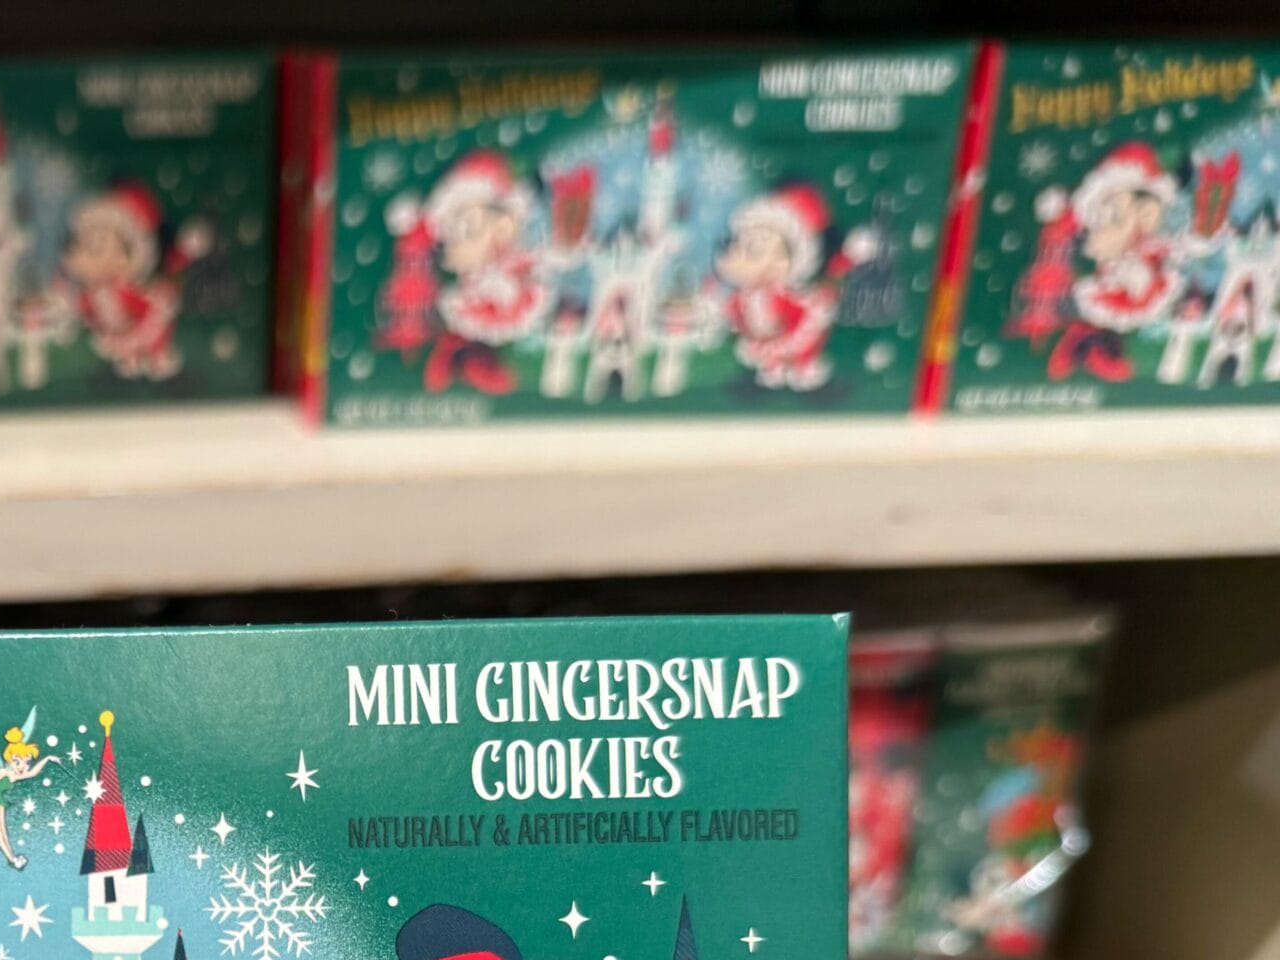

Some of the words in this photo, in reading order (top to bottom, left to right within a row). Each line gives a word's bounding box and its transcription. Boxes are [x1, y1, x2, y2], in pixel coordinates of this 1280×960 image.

[347, 663, 459, 727] MINI
[476, 657, 802, 731] GINGERSNAP
[472, 736, 683, 801] COOKIES
[348, 814, 485, 848] NATURALLY
[493, 814, 512, 846] &
[518, 809, 674, 845] ARTIFICIALLY
[681, 807, 800, 842] FLAVORED
